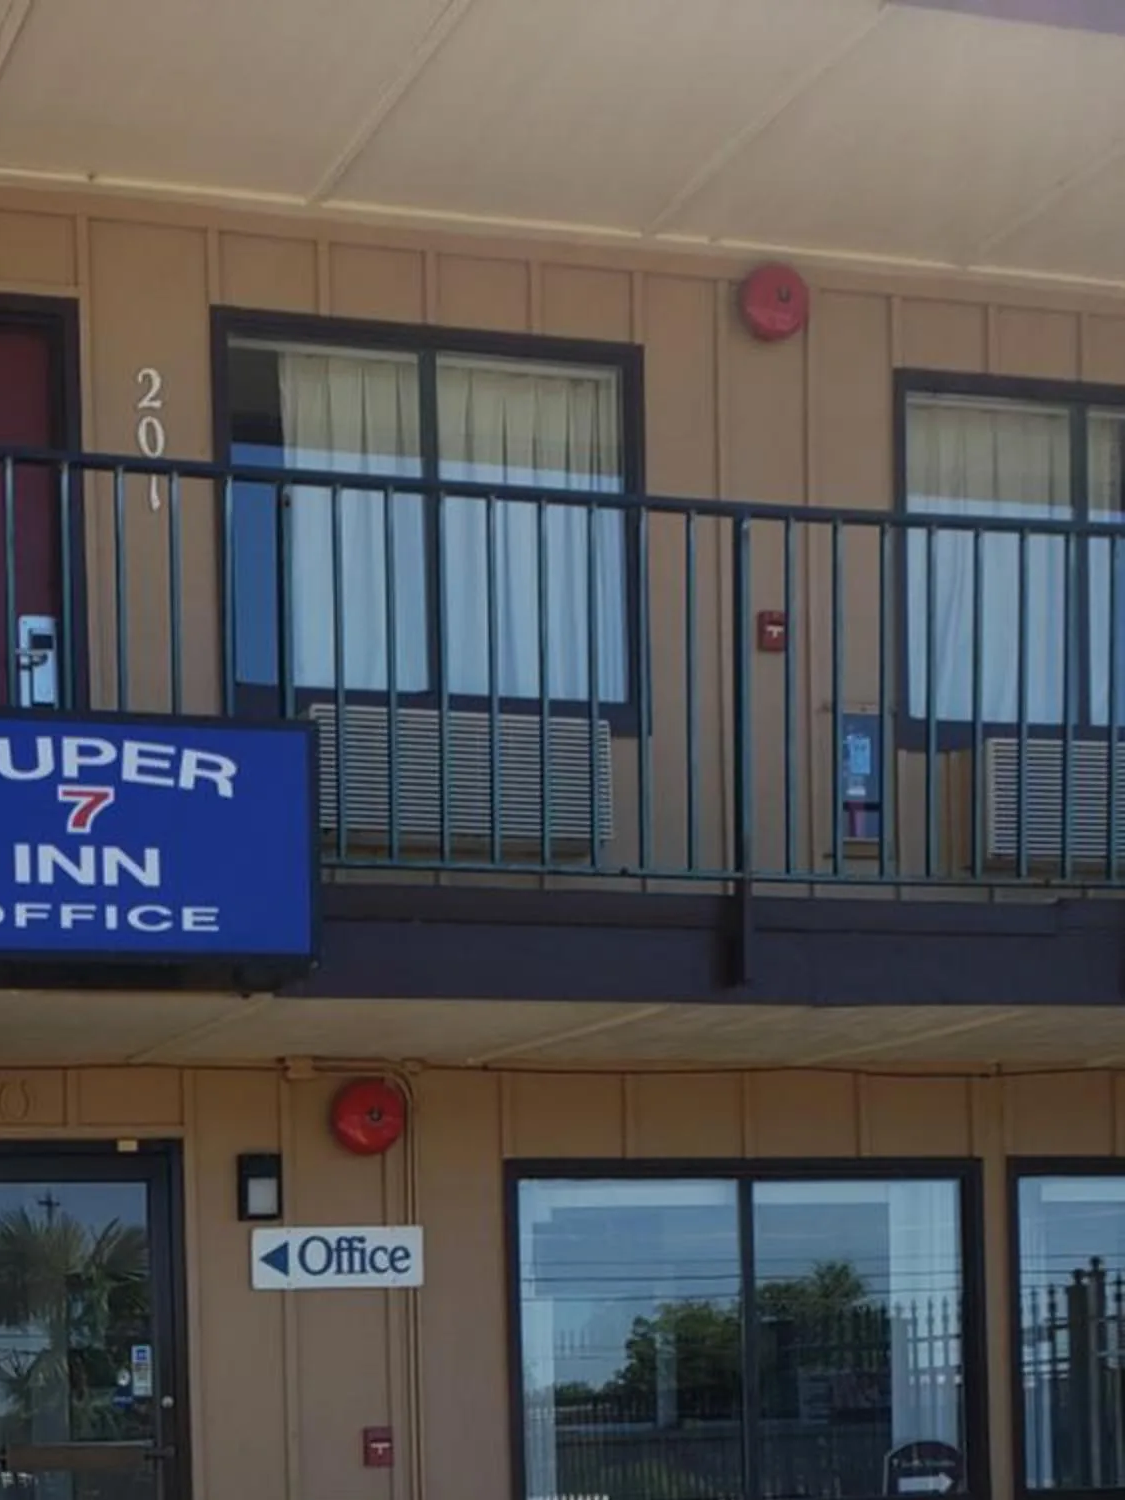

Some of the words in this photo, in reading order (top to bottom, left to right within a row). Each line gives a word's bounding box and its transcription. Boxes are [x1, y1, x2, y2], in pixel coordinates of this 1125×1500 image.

[137, 367, 165, 511] 201
[57, 785, 114, 834] 7
[13, 843, 161, 887] INN
[297, 1235, 411, 1276] Office
